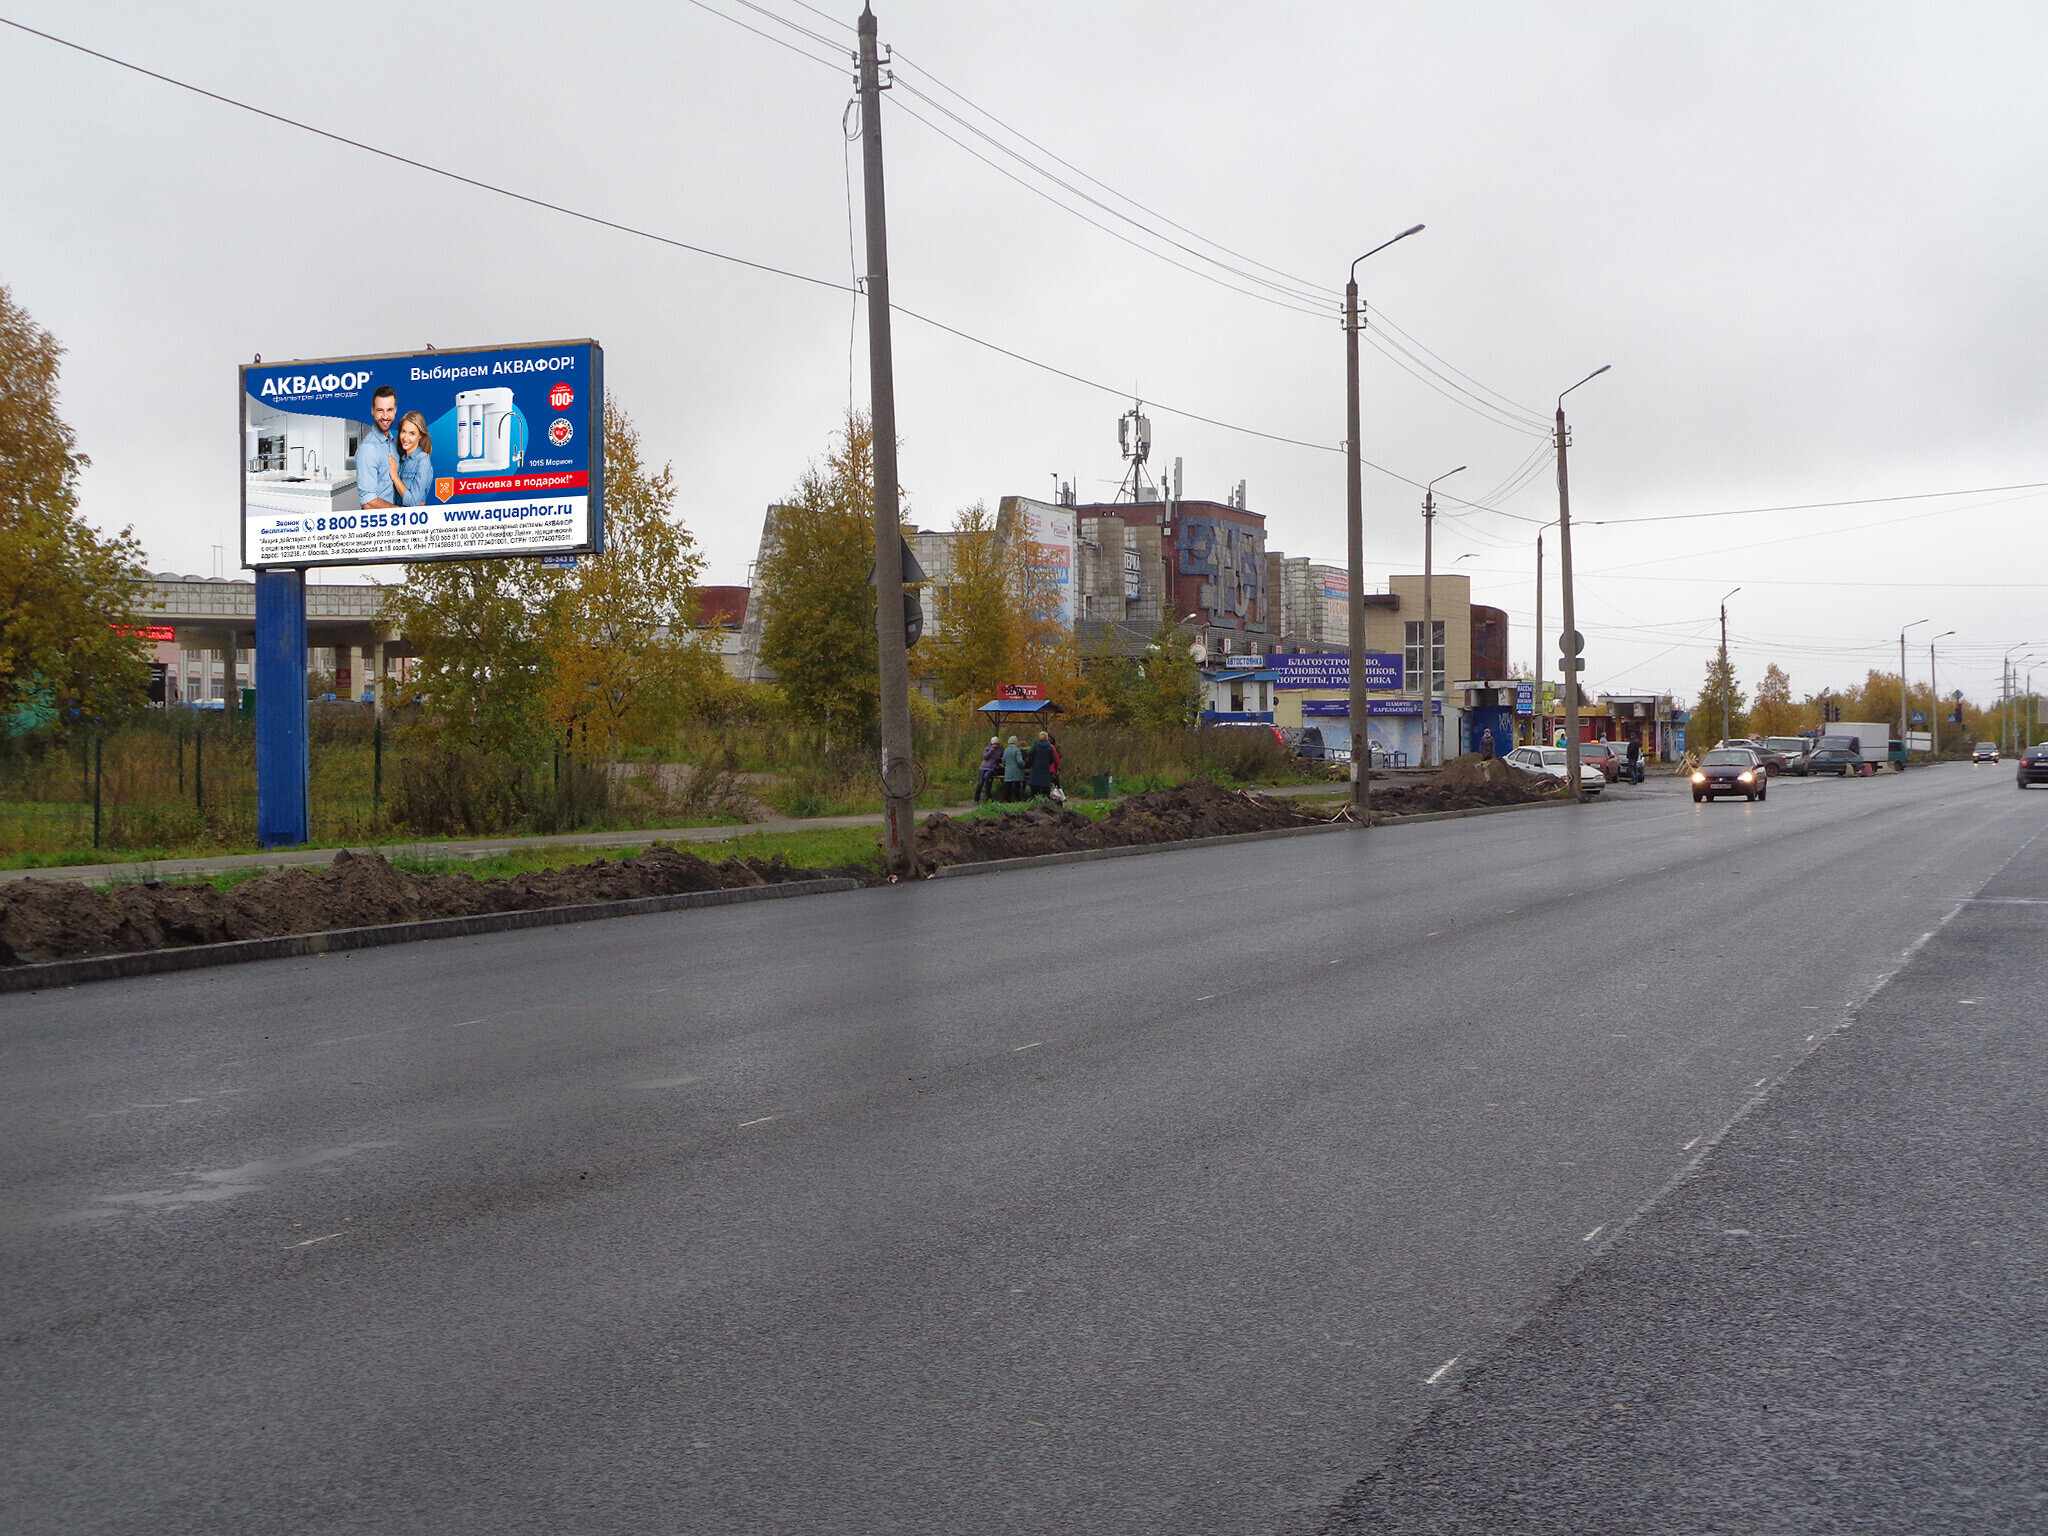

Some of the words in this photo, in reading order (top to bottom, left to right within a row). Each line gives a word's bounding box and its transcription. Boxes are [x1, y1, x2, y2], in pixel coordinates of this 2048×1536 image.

[410, 365, 488, 381] Выбираем
[492, 356, 575, 375] АКВАФОР!
[260, 371, 370, 396] АКВАФОР
[273, 394, 314, 402] фильтры
[546, 458, 573, 466] Морион
[459, 480, 512, 490] Установка
[444, 504, 572, 521] www.aquaphor.ru
[316, 518, 326, 530] 8
[329, 516, 356, 530] 800
[360, 514, 388, 528] 555
[391, 513, 406, 526] 81
[410, 512, 428, 525] 00
[260, 526, 300, 534] бесплатный
[1227, 657, 1262, 666] АВТОСТОЯНКА
